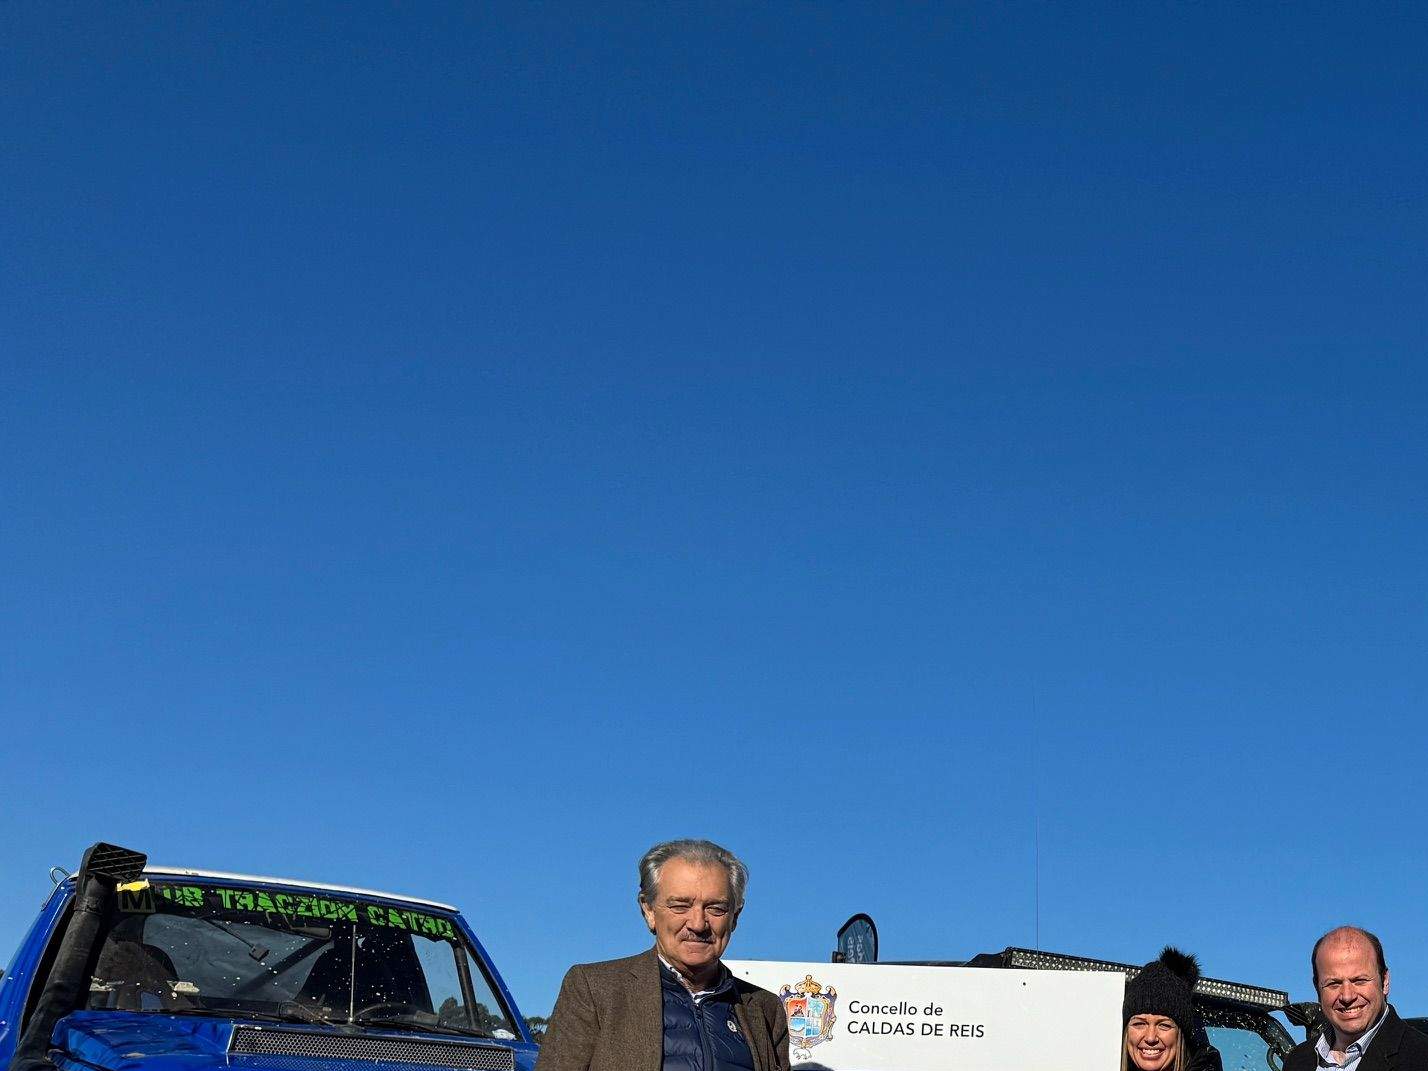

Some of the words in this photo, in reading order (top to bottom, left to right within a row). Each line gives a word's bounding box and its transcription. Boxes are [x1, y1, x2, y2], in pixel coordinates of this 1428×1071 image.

[849, 1000, 918, 1016] Concello
[923, 1002, 943, 1016] de
[847, 1020, 915, 1036] CALDAS
[921, 1022, 944, 1037] DE
[950, 1024, 985, 1038] REIS
